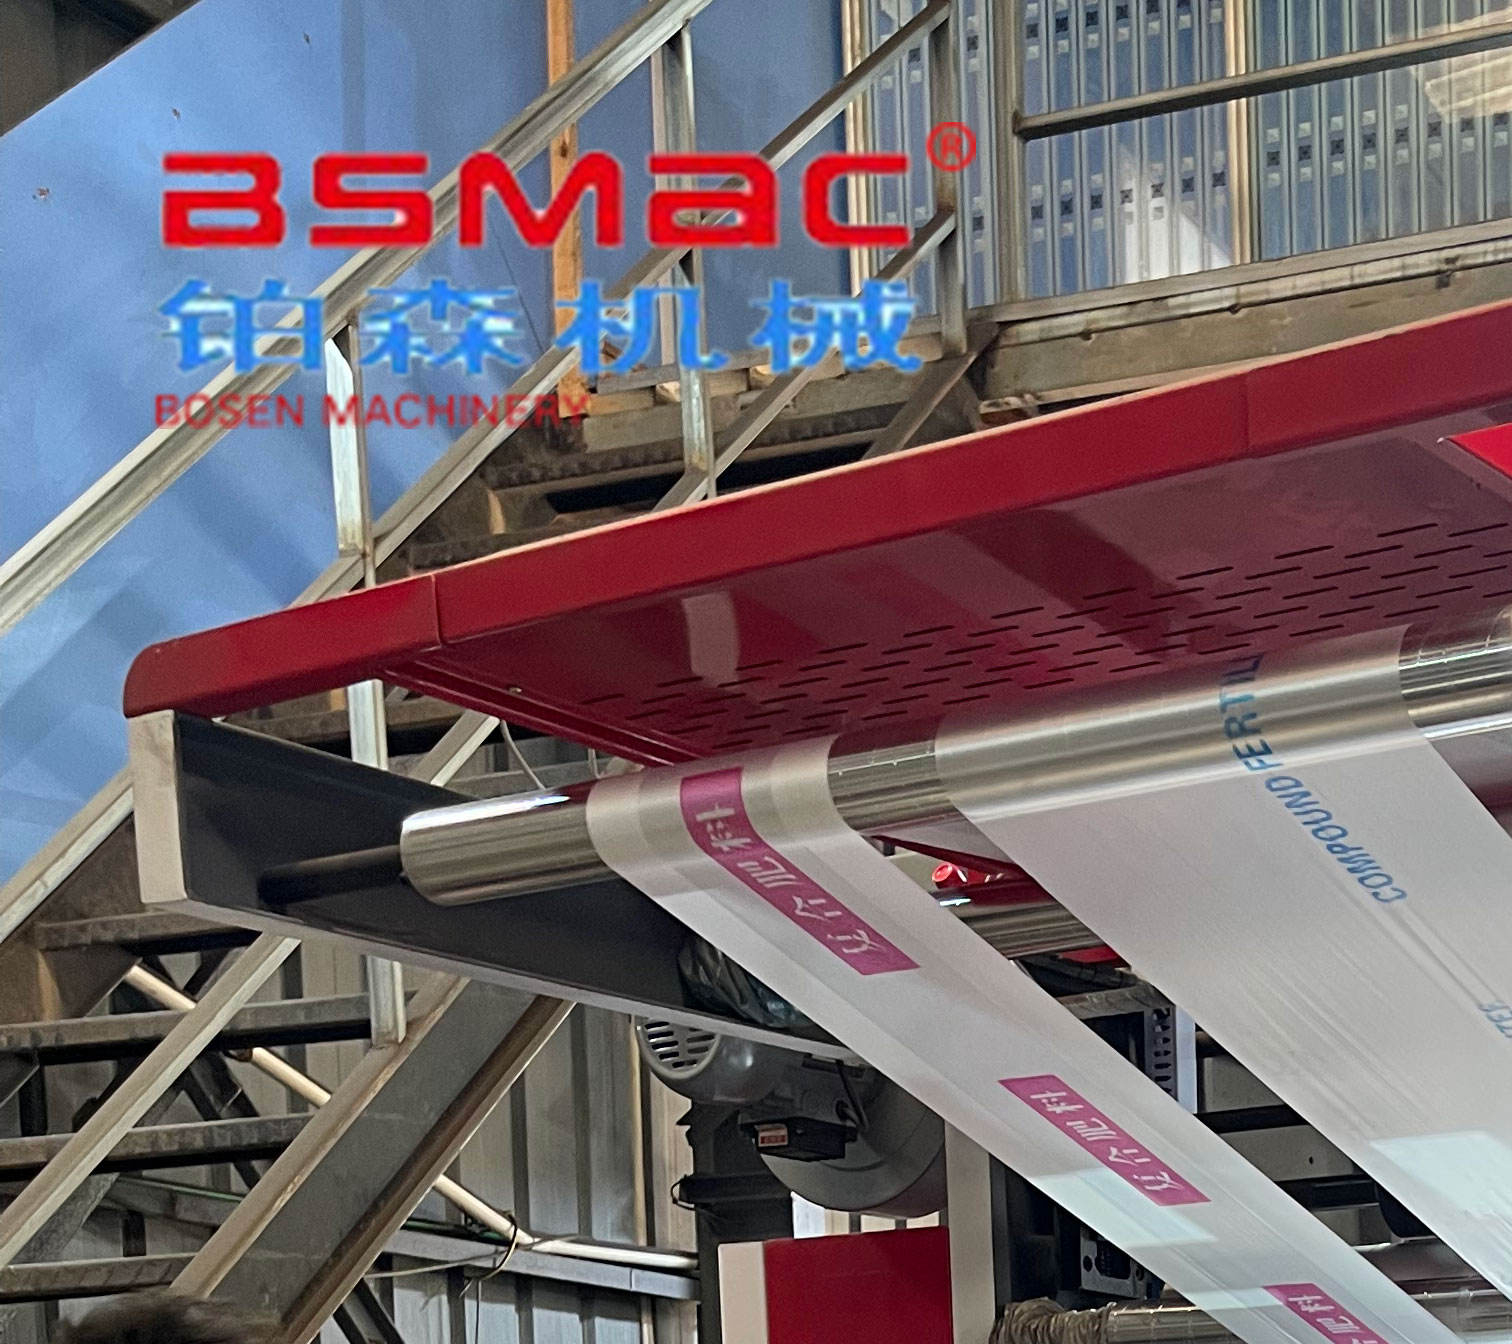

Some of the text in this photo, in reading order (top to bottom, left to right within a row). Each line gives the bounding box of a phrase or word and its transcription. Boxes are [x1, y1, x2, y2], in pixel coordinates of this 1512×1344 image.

[695, 802, 888, 954] 复合肥料
[1264, 775, 1408, 904] COMPOUND
[1029, 1090, 1185, 1191] 复合肥料
